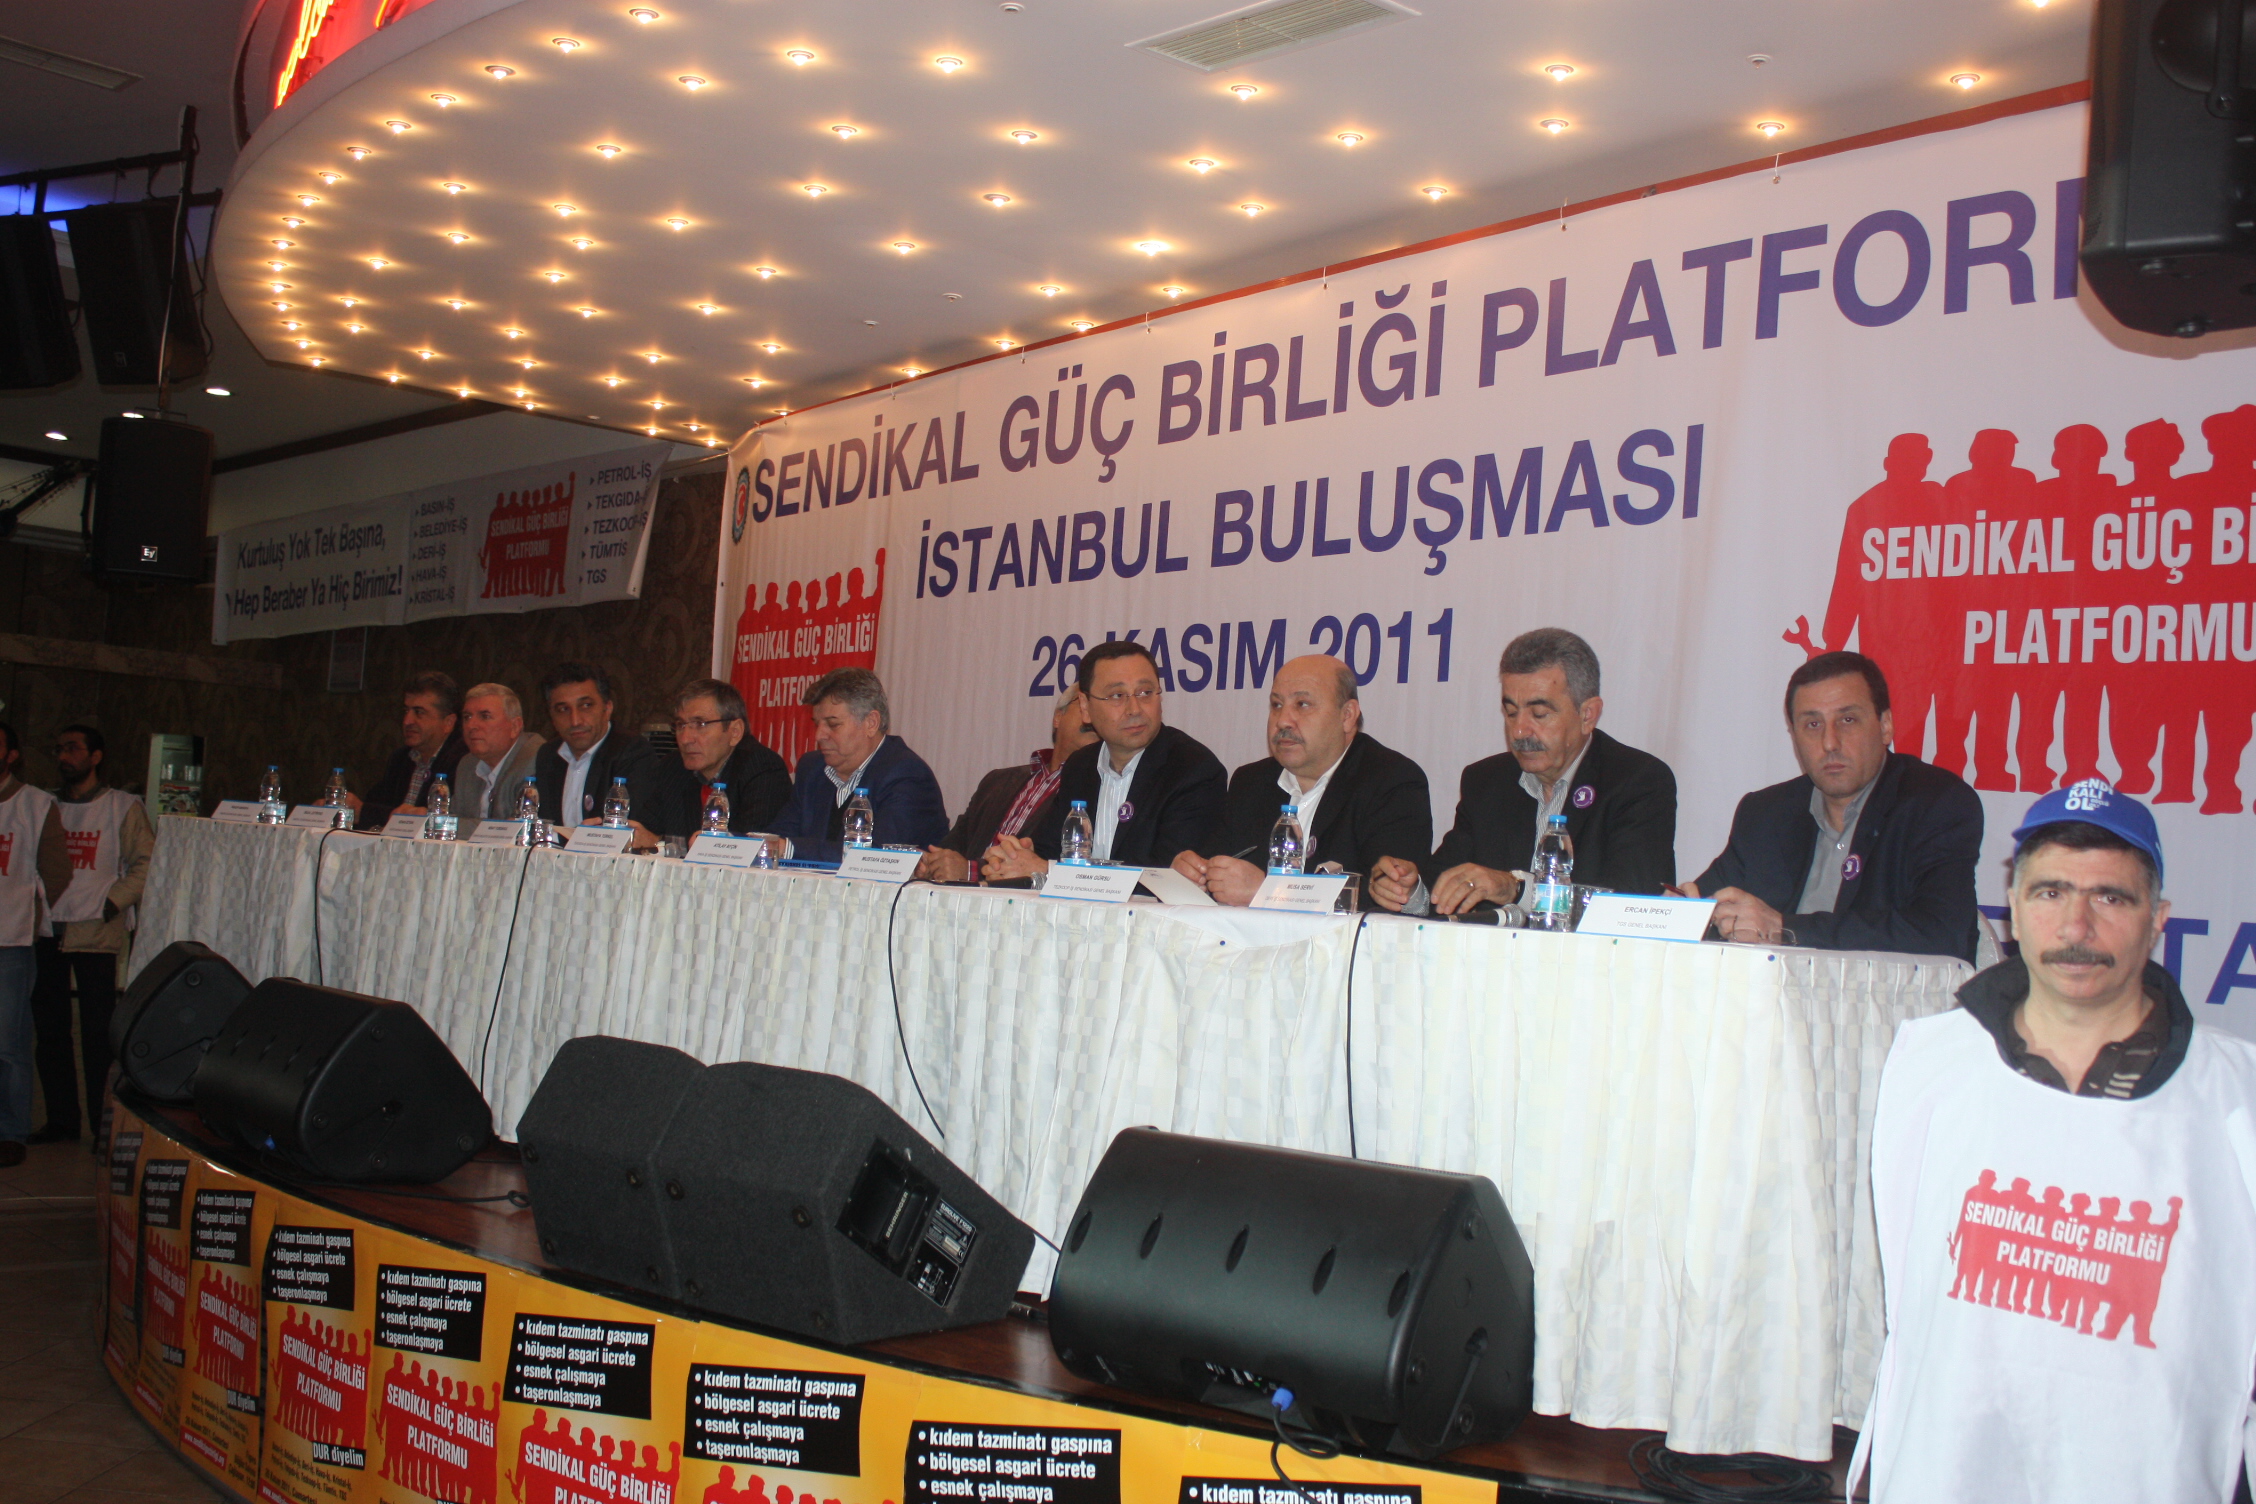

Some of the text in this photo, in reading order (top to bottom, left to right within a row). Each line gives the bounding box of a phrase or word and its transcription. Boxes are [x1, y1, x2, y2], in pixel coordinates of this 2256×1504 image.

[752, 177, 2087, 522] SENDİKAL GÜÇ BİRLİĞİ PLATFOR
[597, 460, 652, 484] PETROL-İŞ
[420, 496, 455, 516] BASIN-İŞ
[915, 424, 1704, 599] İSTANBUL BULUŞMASI
[419, 516, 467, 538] BELEDİYE-İŞ
[491, 505, 570, 537] SENDİKAL GÜÇ BİRLİĞİ
[237, 523, 385, 571] Kurtuluş Yok Tek Başına,
[506, 539, 550, 560] PLATFORMU
[589, 538, 628, 560] TÜMTİS
[1861, 510, 2075, 581] SENDİKAL
[2091, 496, 2192, 584] GÜÇ
[415, 565, 447, 582] HAVA-İŞ
[587, 568, 607, 584] TGS
[233, 565, 403, 620] Hep Beraber Ya Hiç Birimiz!
[414, 586, 455, 604] KRİSTAL-İŞ
[737, 612, 876, 664] SENDİKAL GÜÇ BİRLİĞİ
[1965, 602, 2256, 665] PLATFORMU
[1029, 634, 1085, 697] 26
[2065, 797, 2094, 811] OL
[2069, 788, 2103, 800] KALI
[1075, 873, 1111, 882] OSMAN GÜRSU
[1624, 906, 1673, 916] ERCAN İPEKÇİ
[1644, 923, 1668, 931] BAŞKANI
[278, 1230, 352, 1249] kıdem tazminatı gaspına
[1965, 1200, 2166, 1263] SENDİKAL GÜÇ BİRLİĞİ
[276, 1248, 346, 1266] bölgesel asgari ücrete
[1996, 1240, 2111, 1286] PLATFORMU
[276, 1267, 330, 1285] esnek çalışmaya
[386, 1269, 482, 1294] kıdem tazminatı gaspına
[277, 1285, 328, 1303] taşeronlaşmaya
[386, 1289, 472, 1312] bölgesel asgari ücrete
[386, 1311, 448, 1332] esnek çalışmaya
[526, 1319, 649, 1347] kıdem tazminatı gaspına
[386, 1330, 444, 1352] taşeronlaşmaya
[283, 1334, 365, 1391] SENDİKAL GÜÇ BİRLİĞİ
[524, 1341, 636, 1367] bölgesel asgari ücrete
[523, 1364, 606, 1388] esnek çalışmaya
[704, 1370, 857, 1399] kıdem tazminatı gaspına
[296, 1371, 342, 1412] PLATFORMU
[523, 1384, 602, 1410] taşeronlaşmaya
[387, 1383, 494, 1448] SENDİKAL GÜÇ BİRLİĞİ
[704, 1392, 841, 1420] bölgesel asgari ücrete
[705, 1417, 805, 1443] esnek çalışmaya
[929, 1427, 1113, 1457] kıdem tazminatı gaspına
[313, 1442, 364, 1467] DUR diyelim
[407, 1424, 468, 1470] PLATFORMU
[705, 1439, 801, 1466] taşeronlaşmaya
[525, 1441, 586, 1483] SENDİKAL
[589, 1461, 617, 1499] GÜÇ
[620, 1473, 671, 1504] BİRLİĞİ
[929, 1452, 1097, 1479] bölgesel asgari ücrete
[930, 1479, 1054, 1504] esnek çalışmaya
[1202, 1483, 1254, 1504] kıdem
